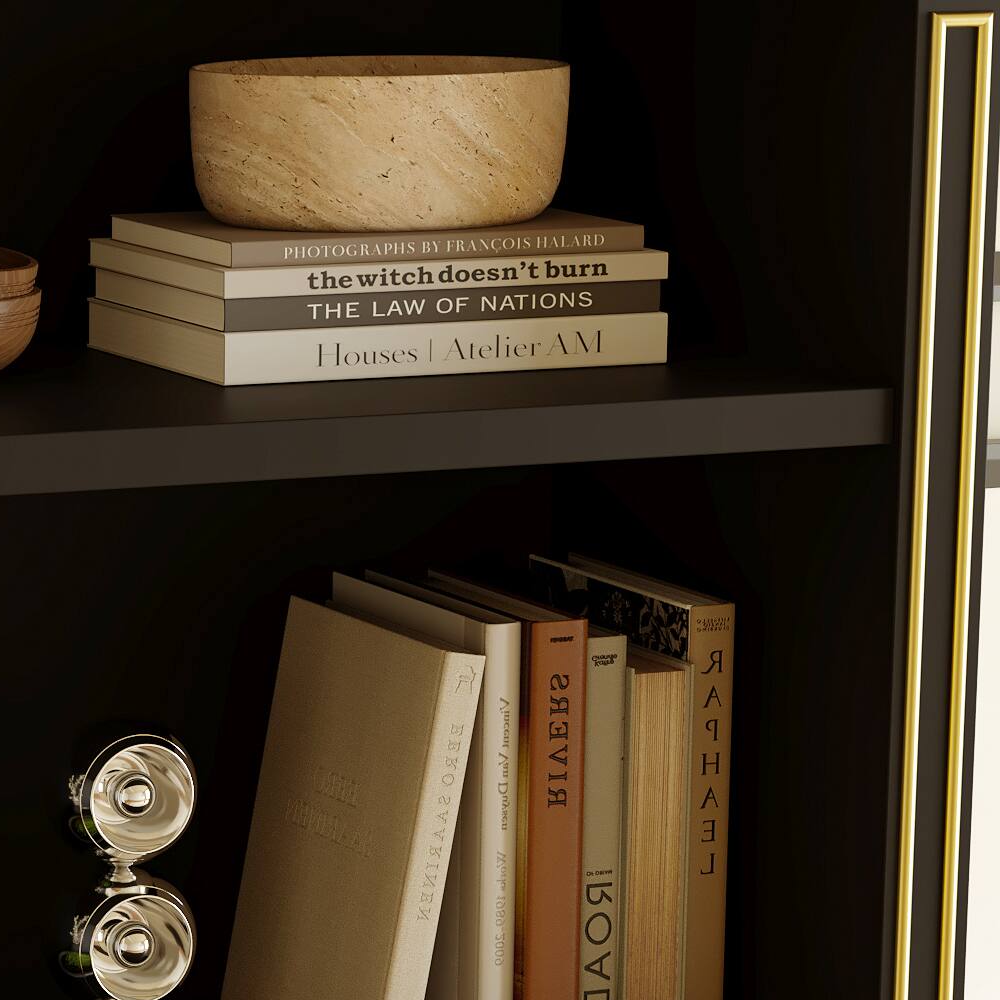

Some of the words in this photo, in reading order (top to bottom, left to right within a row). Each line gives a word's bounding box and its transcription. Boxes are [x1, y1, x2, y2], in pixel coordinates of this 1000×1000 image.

[284, 242, 415, 259] PHOTOGRAPHS
[422, 241, 441, 253] BY
[446, 237, 531, 252] FRANÇOIS
[537, 234, 605, 248] HALARD
[307, 270, 352, 289] the
[356, 266, 434, 287] witch
[438, 261, 539, 283] doesn’t
[545, 260, 608, 279] burn
[307, 302, 360, 320] THE
[372, 299, 425, 317] LAW
[436, 297, 469, 314] OF
[481, 291, 593, 312] NATIONS
[317, 343, 418, 367] Houses
[443, 334, 542, 361] Atelier
[546, 329, 605, 356] AM
